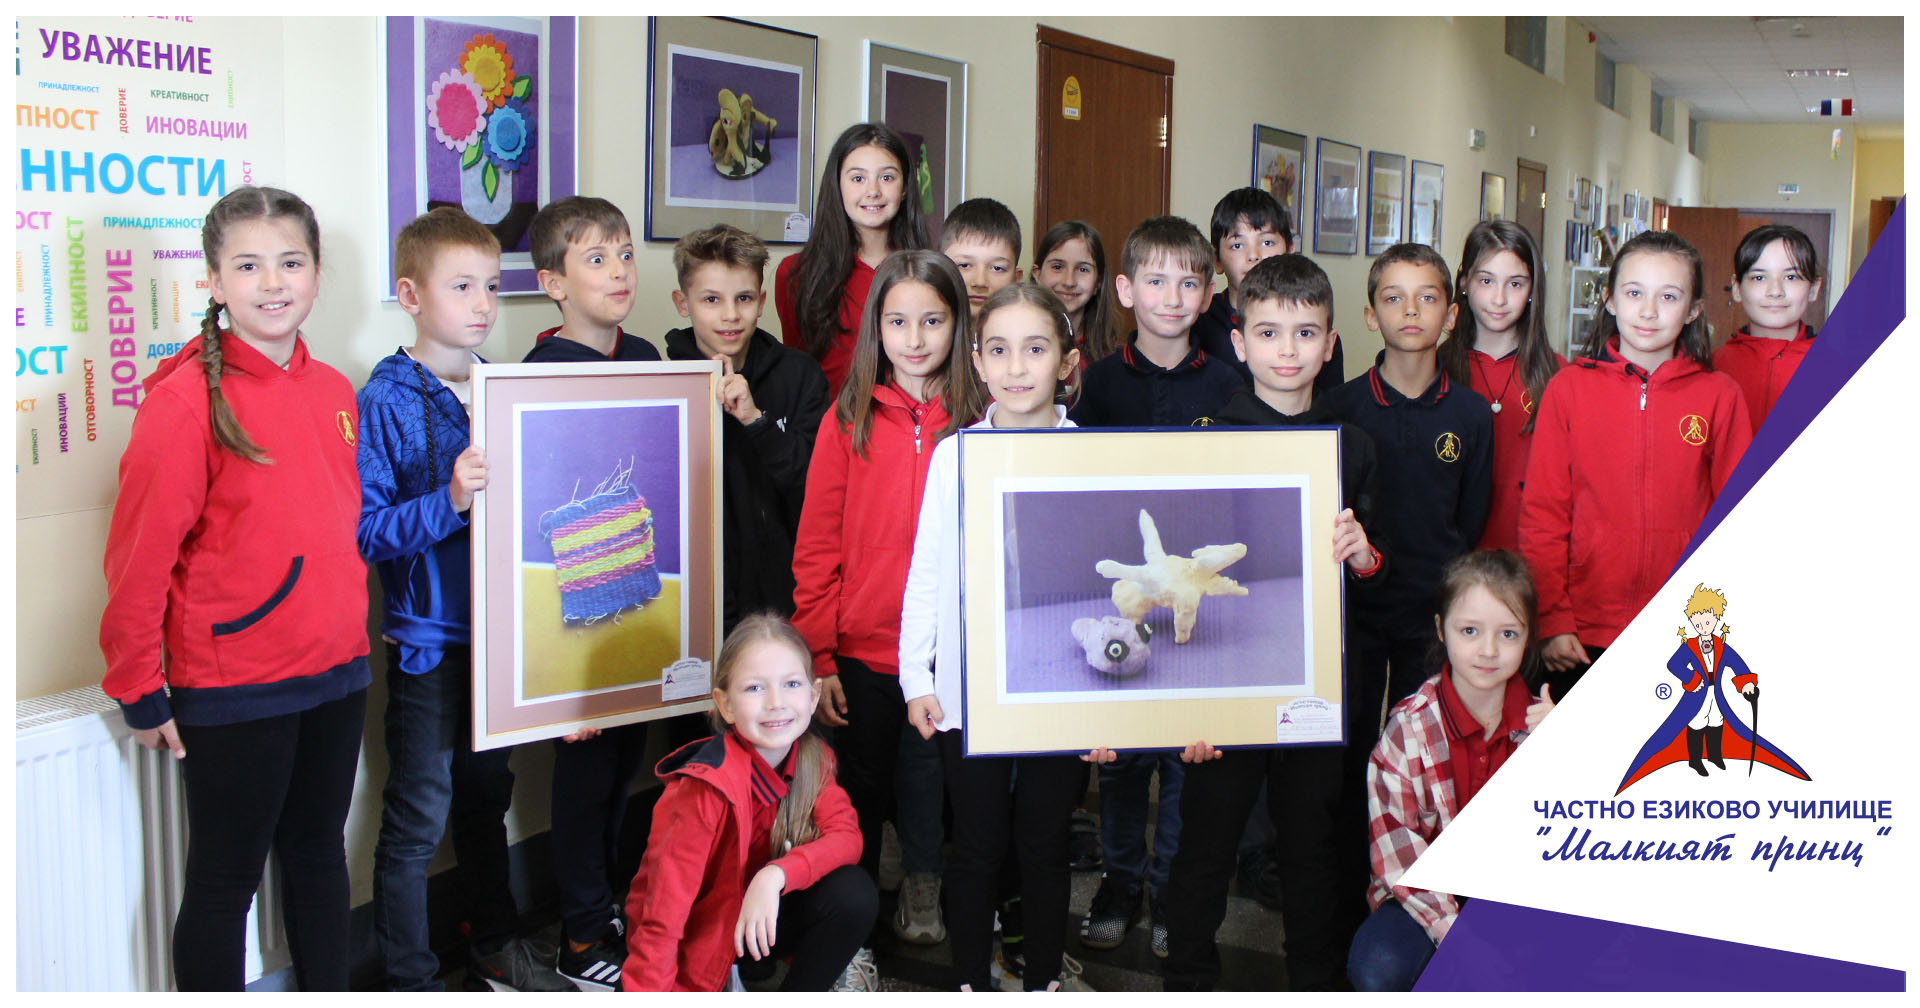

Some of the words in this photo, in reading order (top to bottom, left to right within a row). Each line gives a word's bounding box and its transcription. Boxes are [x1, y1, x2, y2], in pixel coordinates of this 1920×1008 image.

[39, 28, 213, 75] УВАЖЕНИЕ
[118, 87, 128, 134] ДОВЕРИЕ
[150, 89, 209, 102] КРЕАТИВНОСТ
[146, 115, 248, 141] ИНОВАЦИИ
[16, 148, 226, 197] ННОСТИ
[103, 216, 203, 230] ПРИНАДЛЕЖНОСТ
[66, 216, 88, 333] ЕКИПНОСТ
[153, 249, 204, 260] УВАЖЕНИЕ
[105, 249, 142, 410] ДОВЕРИЕ
[57, 393, 69, 453] ИНОВАЦИИ
[83, 358, 97, 442] ОТГОВОРНОСТ
